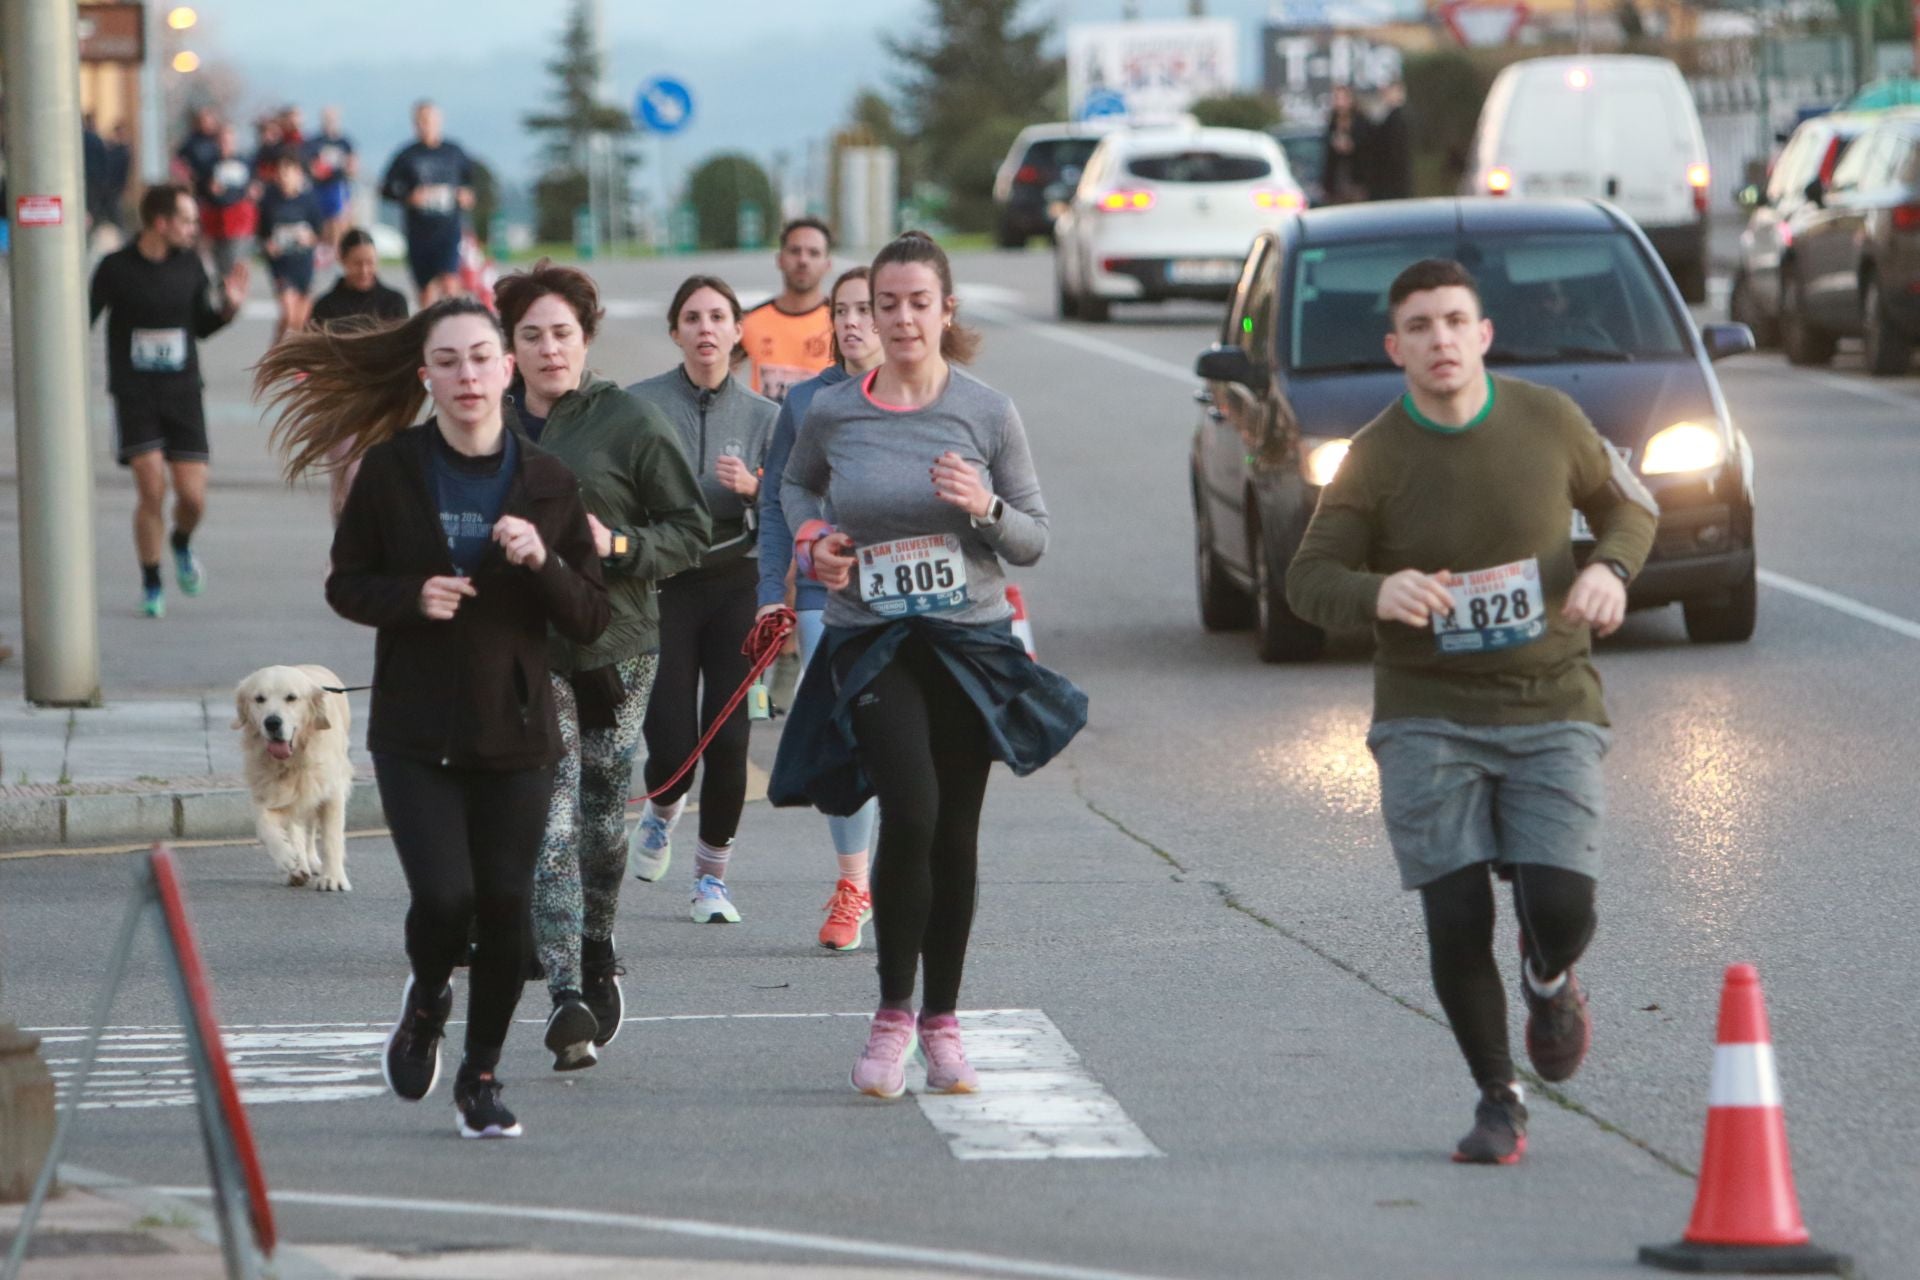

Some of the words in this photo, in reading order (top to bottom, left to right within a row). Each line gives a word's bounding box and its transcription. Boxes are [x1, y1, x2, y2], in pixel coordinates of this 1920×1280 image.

[461, 511, 483, 523] 2024
[872, 543, 892, 557] SAN
[895, 535, 945, 553] SILVESTRE
[894, 558, 954, 595] 805
[1468, 588, 1530, 629] 828
